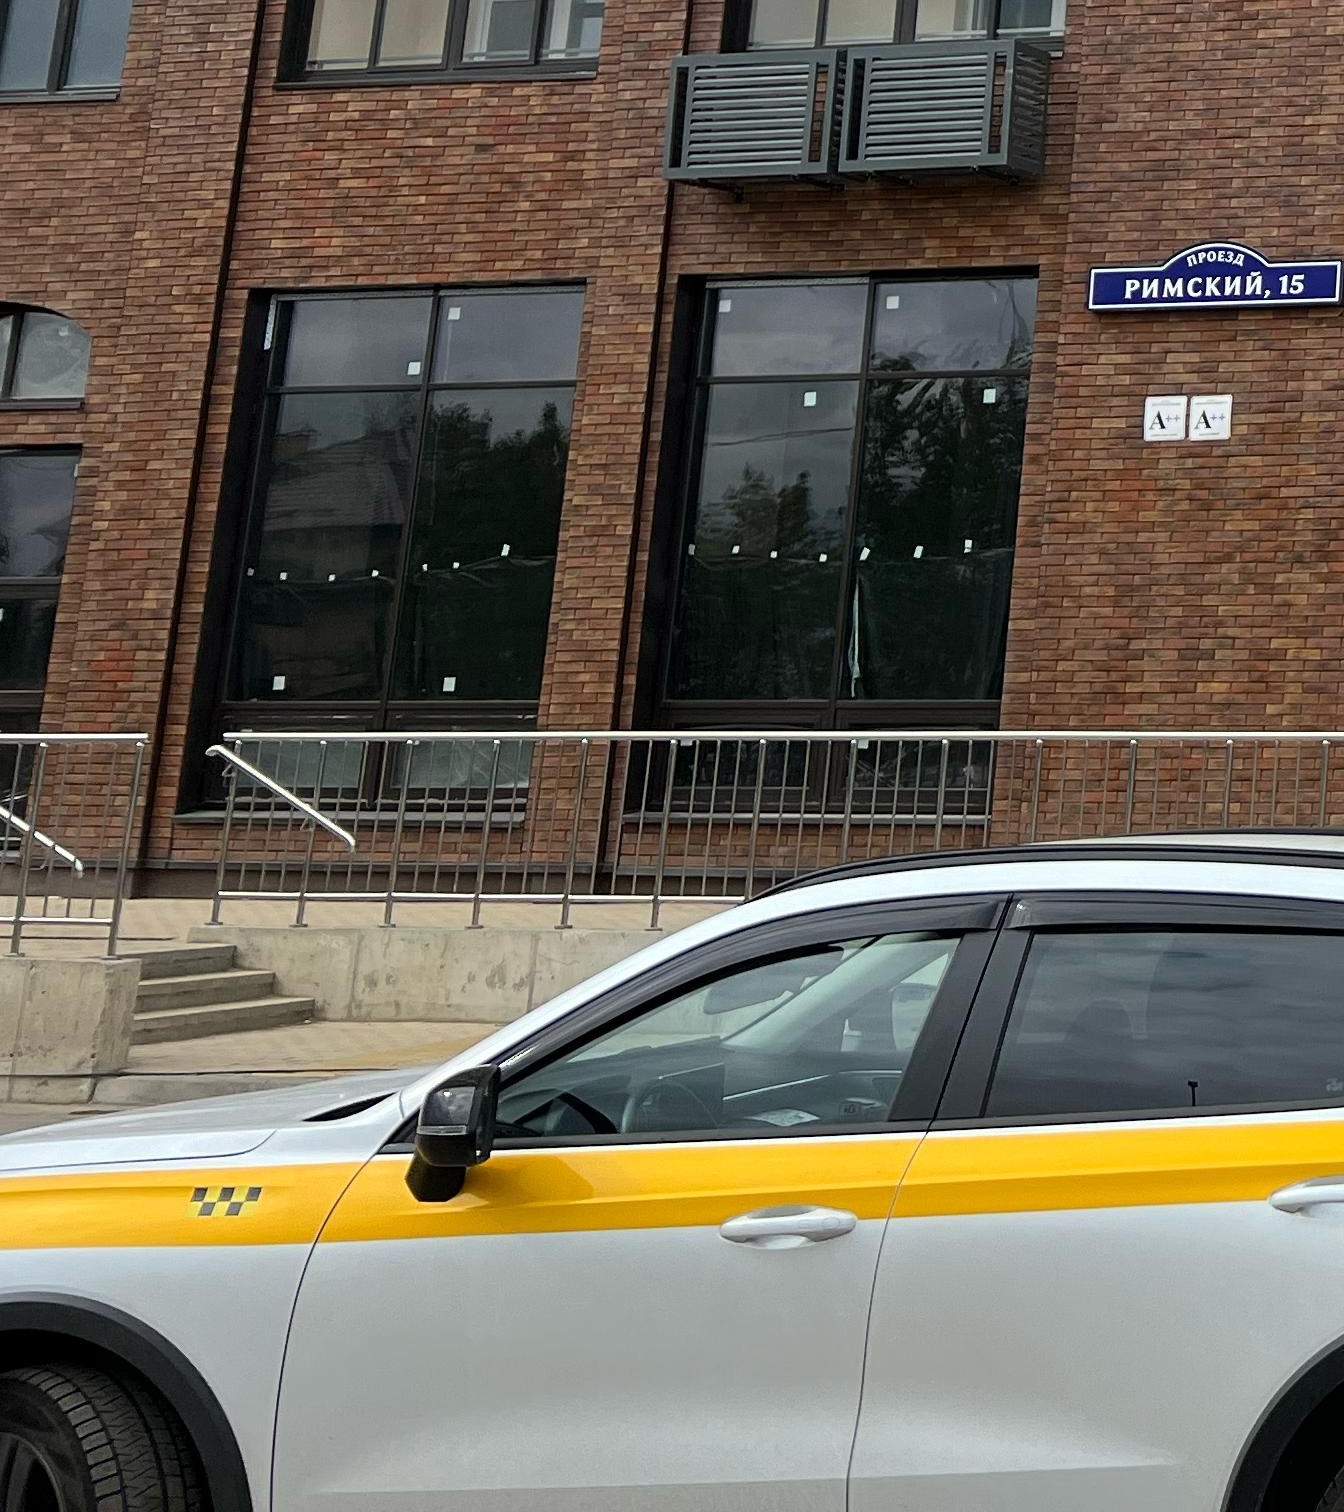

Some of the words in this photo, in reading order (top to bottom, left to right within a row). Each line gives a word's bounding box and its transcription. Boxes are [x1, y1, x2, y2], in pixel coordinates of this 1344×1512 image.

[1186, 250, 1245, 267] ПРОЕЗД
[1124, 271, 1271, 299] РИМСКИЙ,
[1278, 274, 1305, 295] 15
